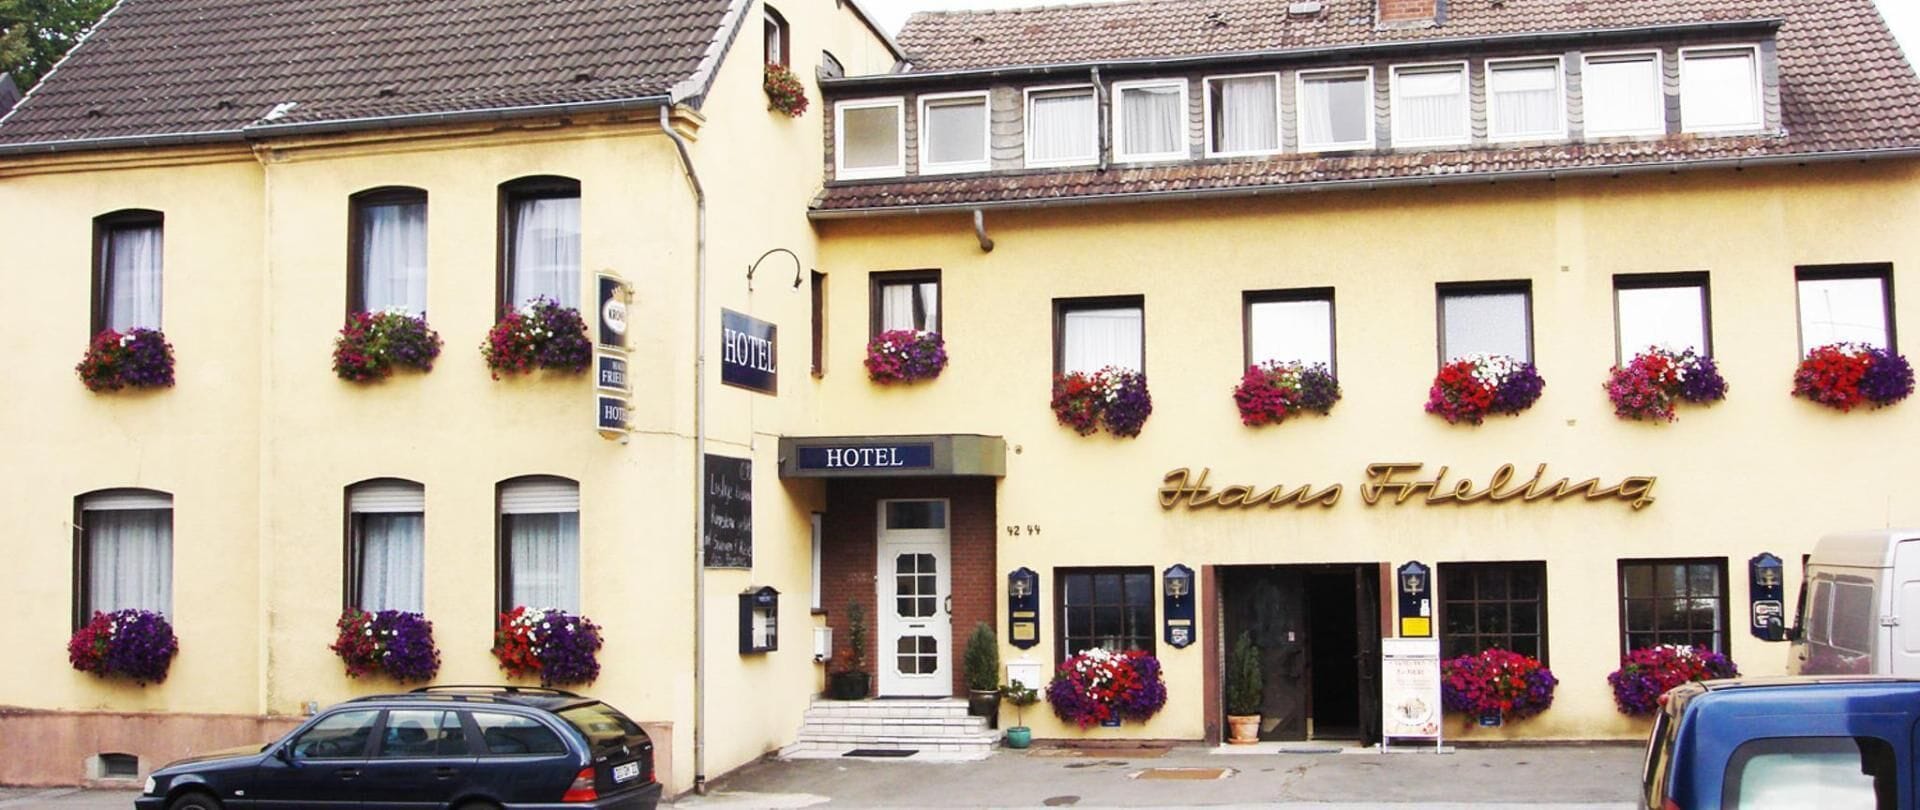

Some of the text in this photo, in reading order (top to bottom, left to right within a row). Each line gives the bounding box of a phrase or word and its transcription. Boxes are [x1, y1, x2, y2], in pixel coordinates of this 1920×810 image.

[724, 328, 776, 373] HOTEL
[826, 448, 903, 467] HOTEL
[1158, 462, 1658, 510] Haus Frieling
[1006, 524, 1040, 536] 42 44
